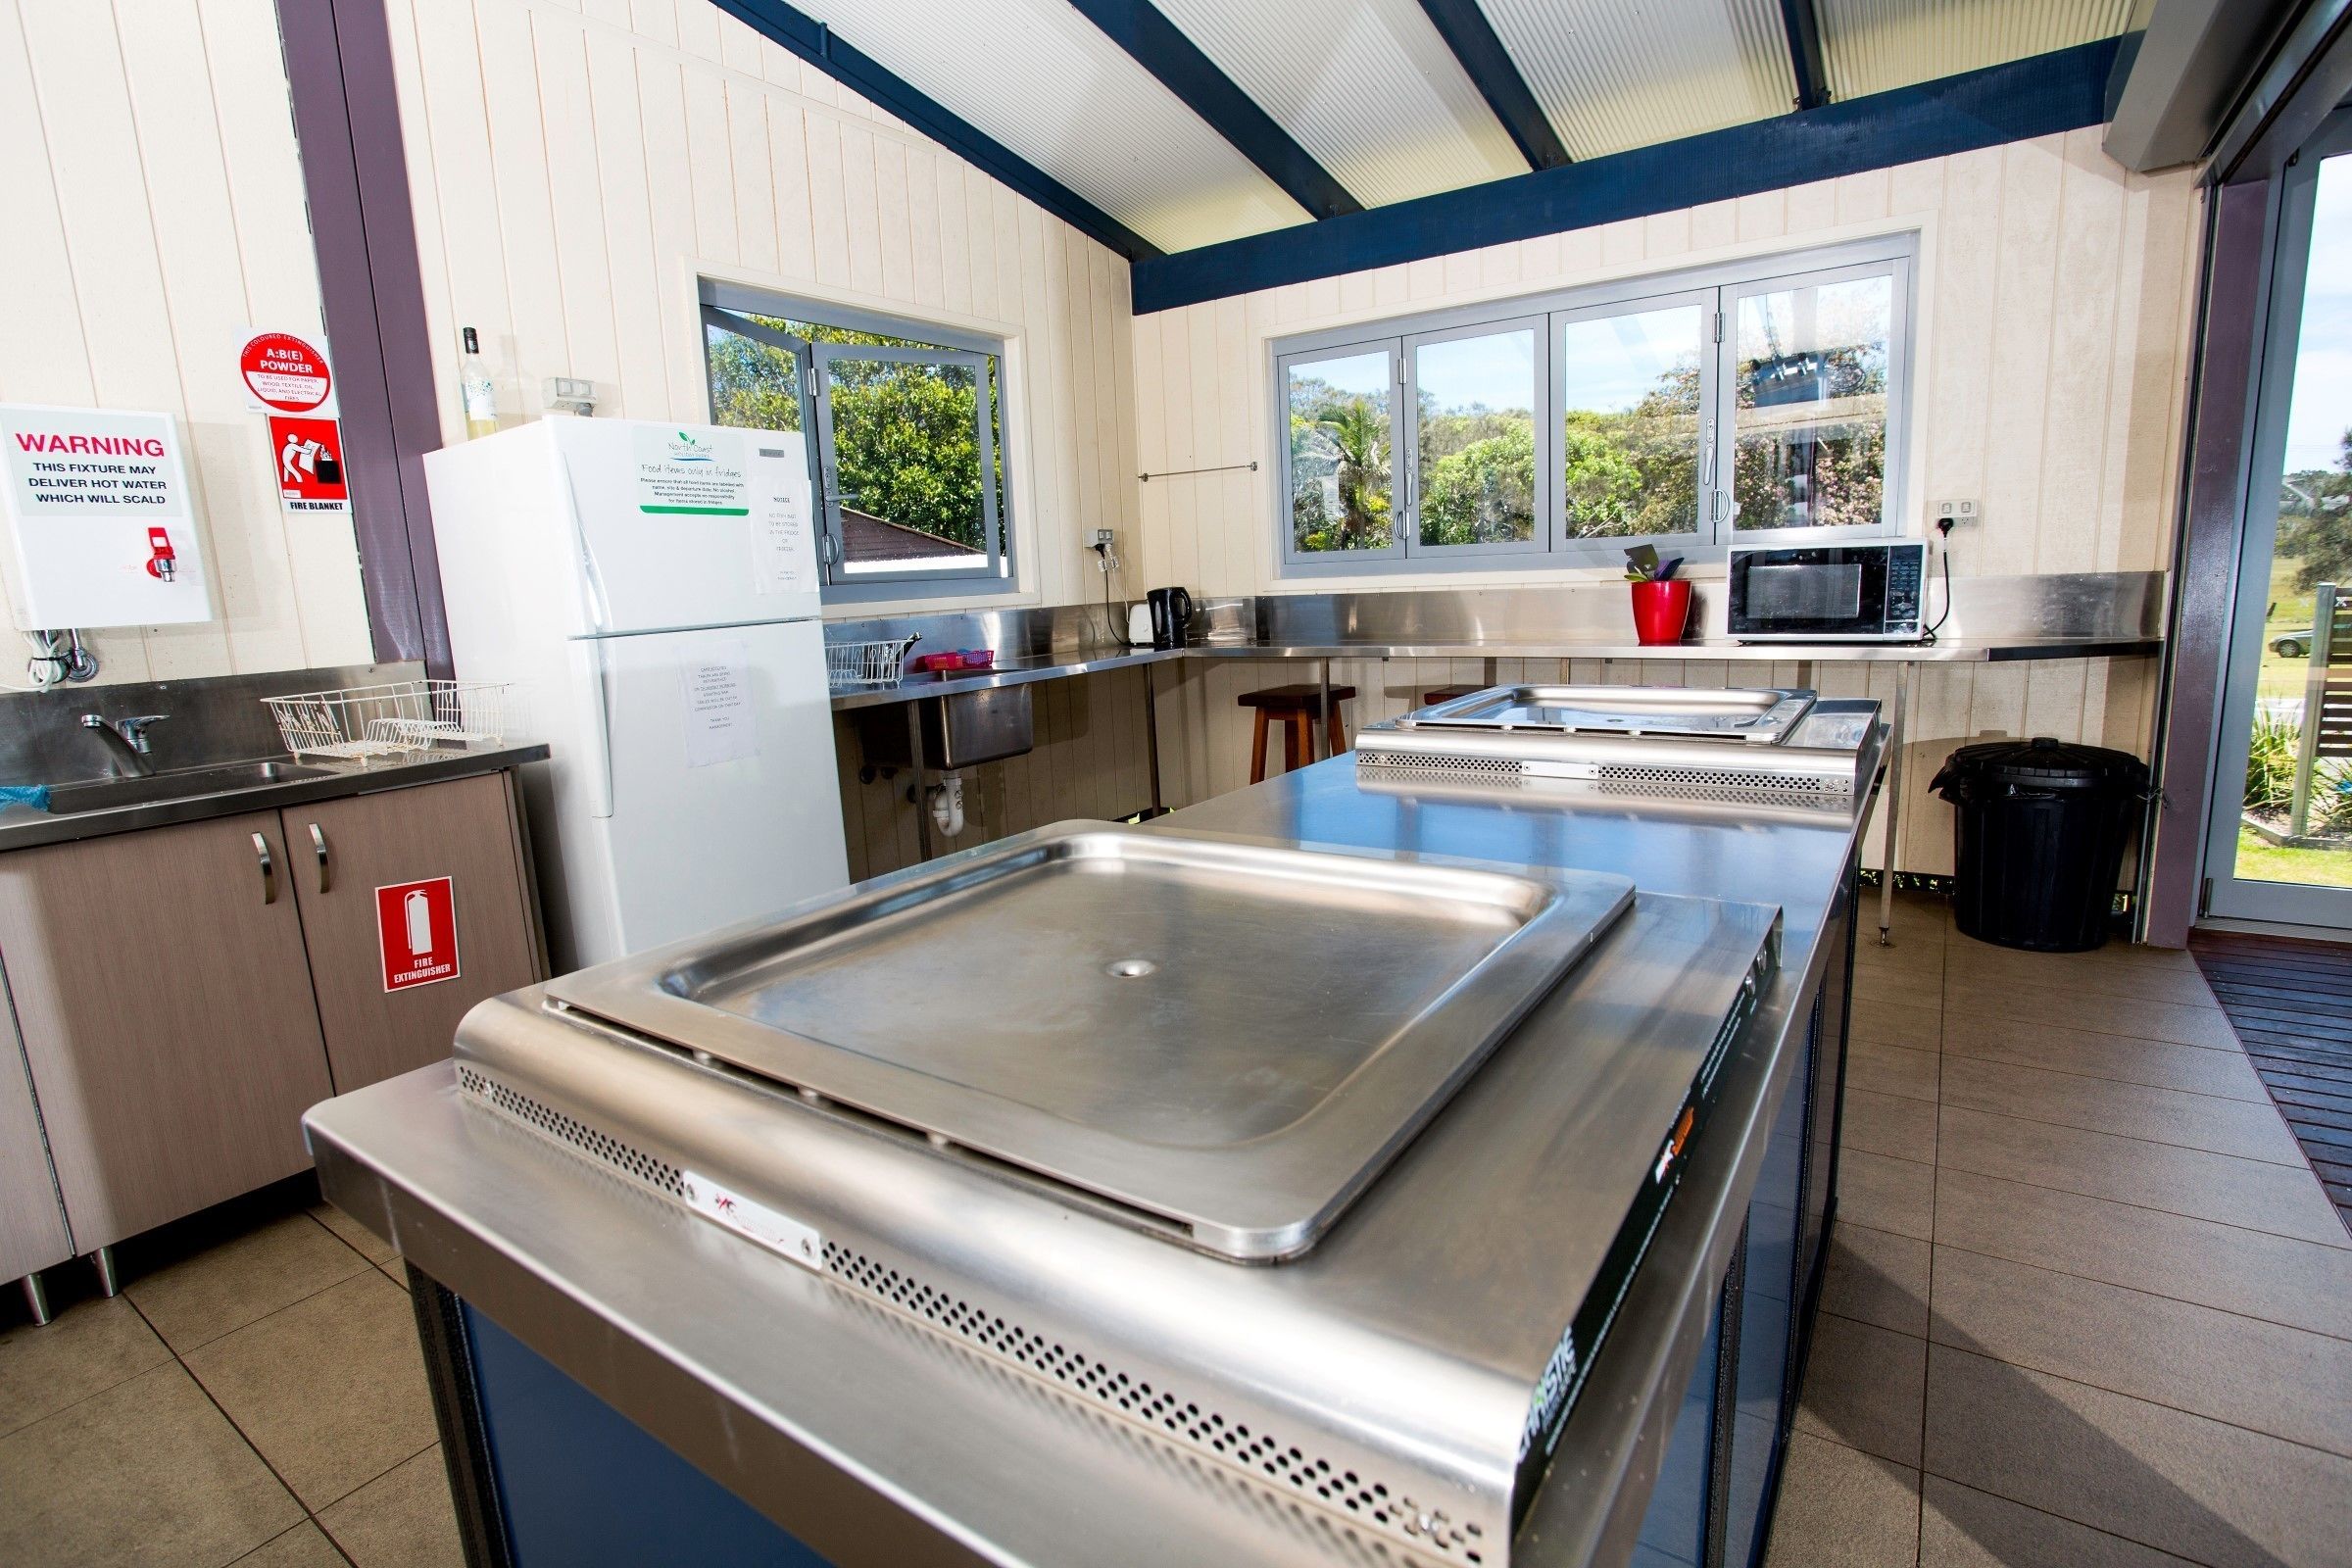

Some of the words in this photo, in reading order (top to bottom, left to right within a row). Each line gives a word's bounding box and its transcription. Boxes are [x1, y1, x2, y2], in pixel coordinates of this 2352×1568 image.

[266, 348, 303, 362] A:B(E)
[260, 360, 313, 374] POWDER
[15, 433, 165, 457] WARNING
[668, 441, 691, 452] North
[693, 444, 712, 453] Coast
[33, 463, 66, 472] THIS
[70, 464, 126, 474] FIXTURE
[129, 466, 156, 475] MAY
[641, 465, 662, 474] Food
[664, 464, 686, 474] items
[687, 467, 704, 478] only
[715, 466, 741, 478] fridges
[28, 478, 88, 488] DELIVER
[91, 480, 119, 489] HOT
[122, 480, 167, 490] WATER
[36, 493, 84, 503] WHICH
[86, 494, 120, 504] WILL
[123, 495, 166, 504] SCALD
[290, 501, 307, 510] FIRE
[309, 502, 343, 510] BLANKET
[414, 956, 433, 969] FIRE
[394, 964, 451, 983] EXTINGUISHER
